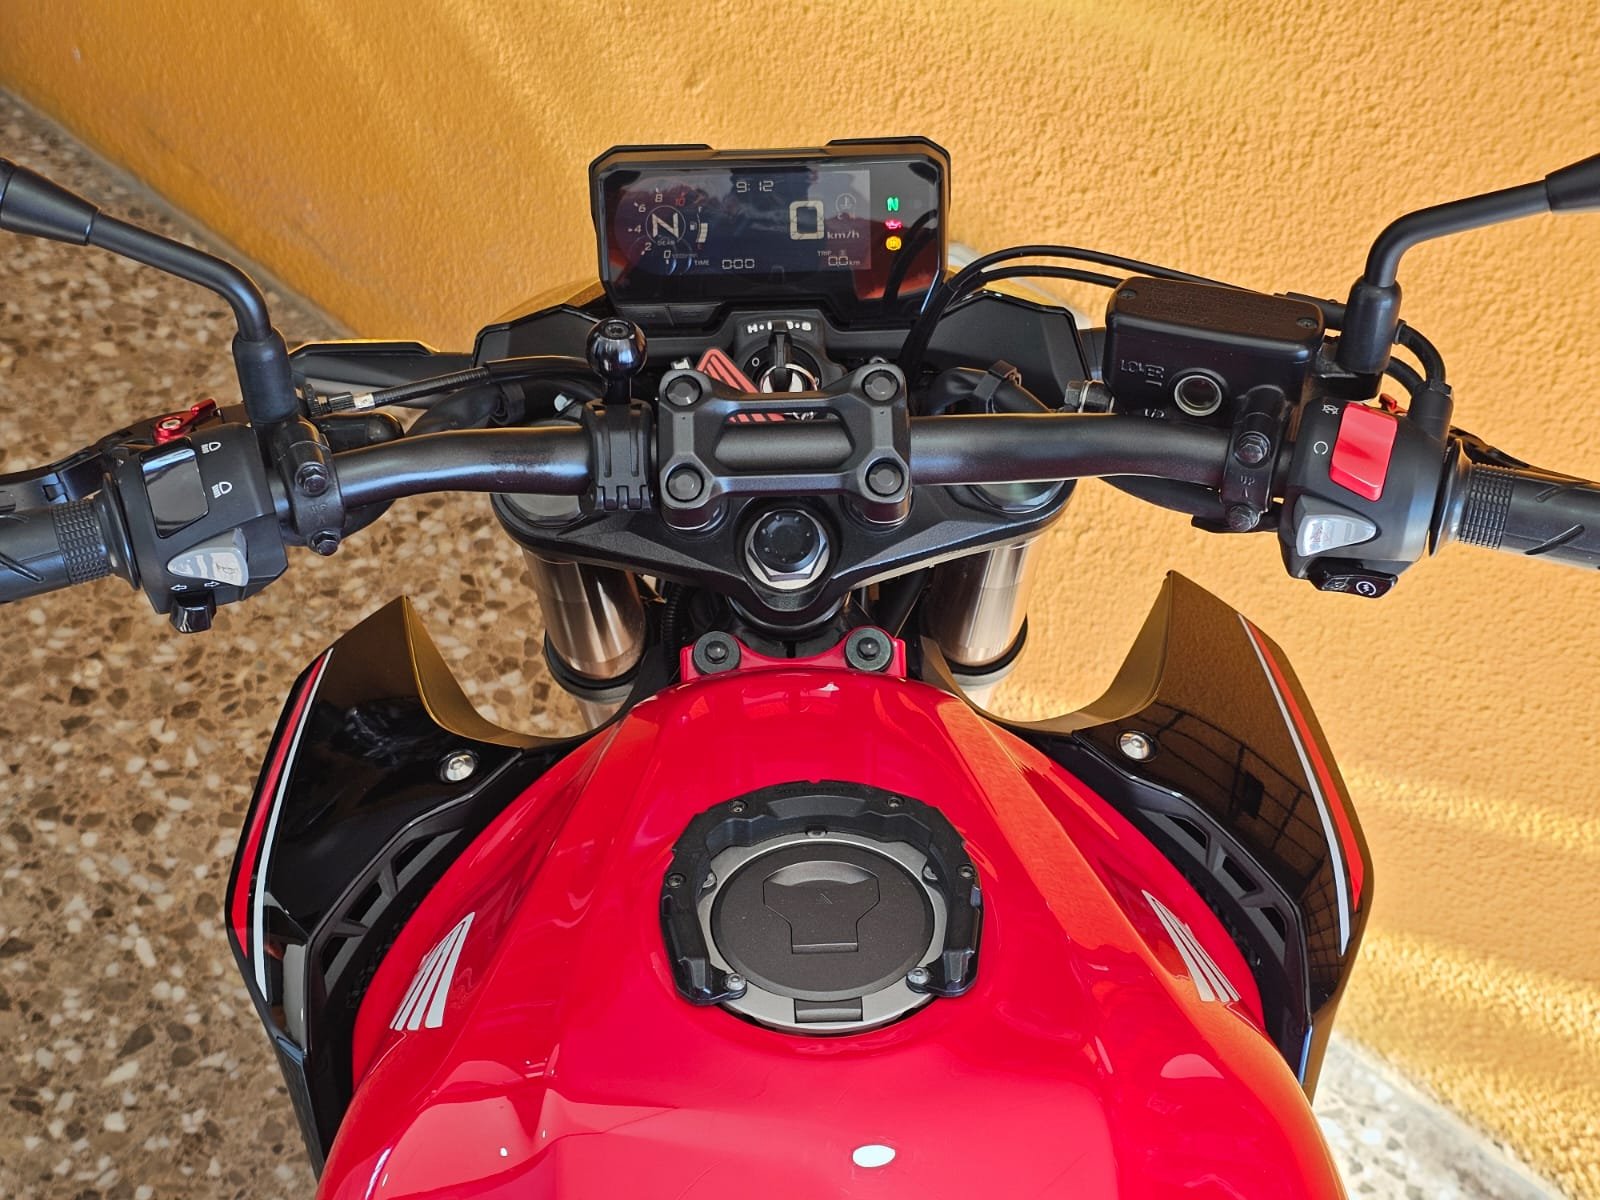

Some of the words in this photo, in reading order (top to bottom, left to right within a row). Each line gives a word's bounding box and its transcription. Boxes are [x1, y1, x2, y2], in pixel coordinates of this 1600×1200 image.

[887, 197, 899, 211] N
[651, 212, 679, 238] N
[789, 201, 824, 240] 0
[634, 224, 642, 234] 4
[827, 231, 860, 239] km/h
[644, 241, 652, 252] 2
[694, 259, 711, 267] TIME
